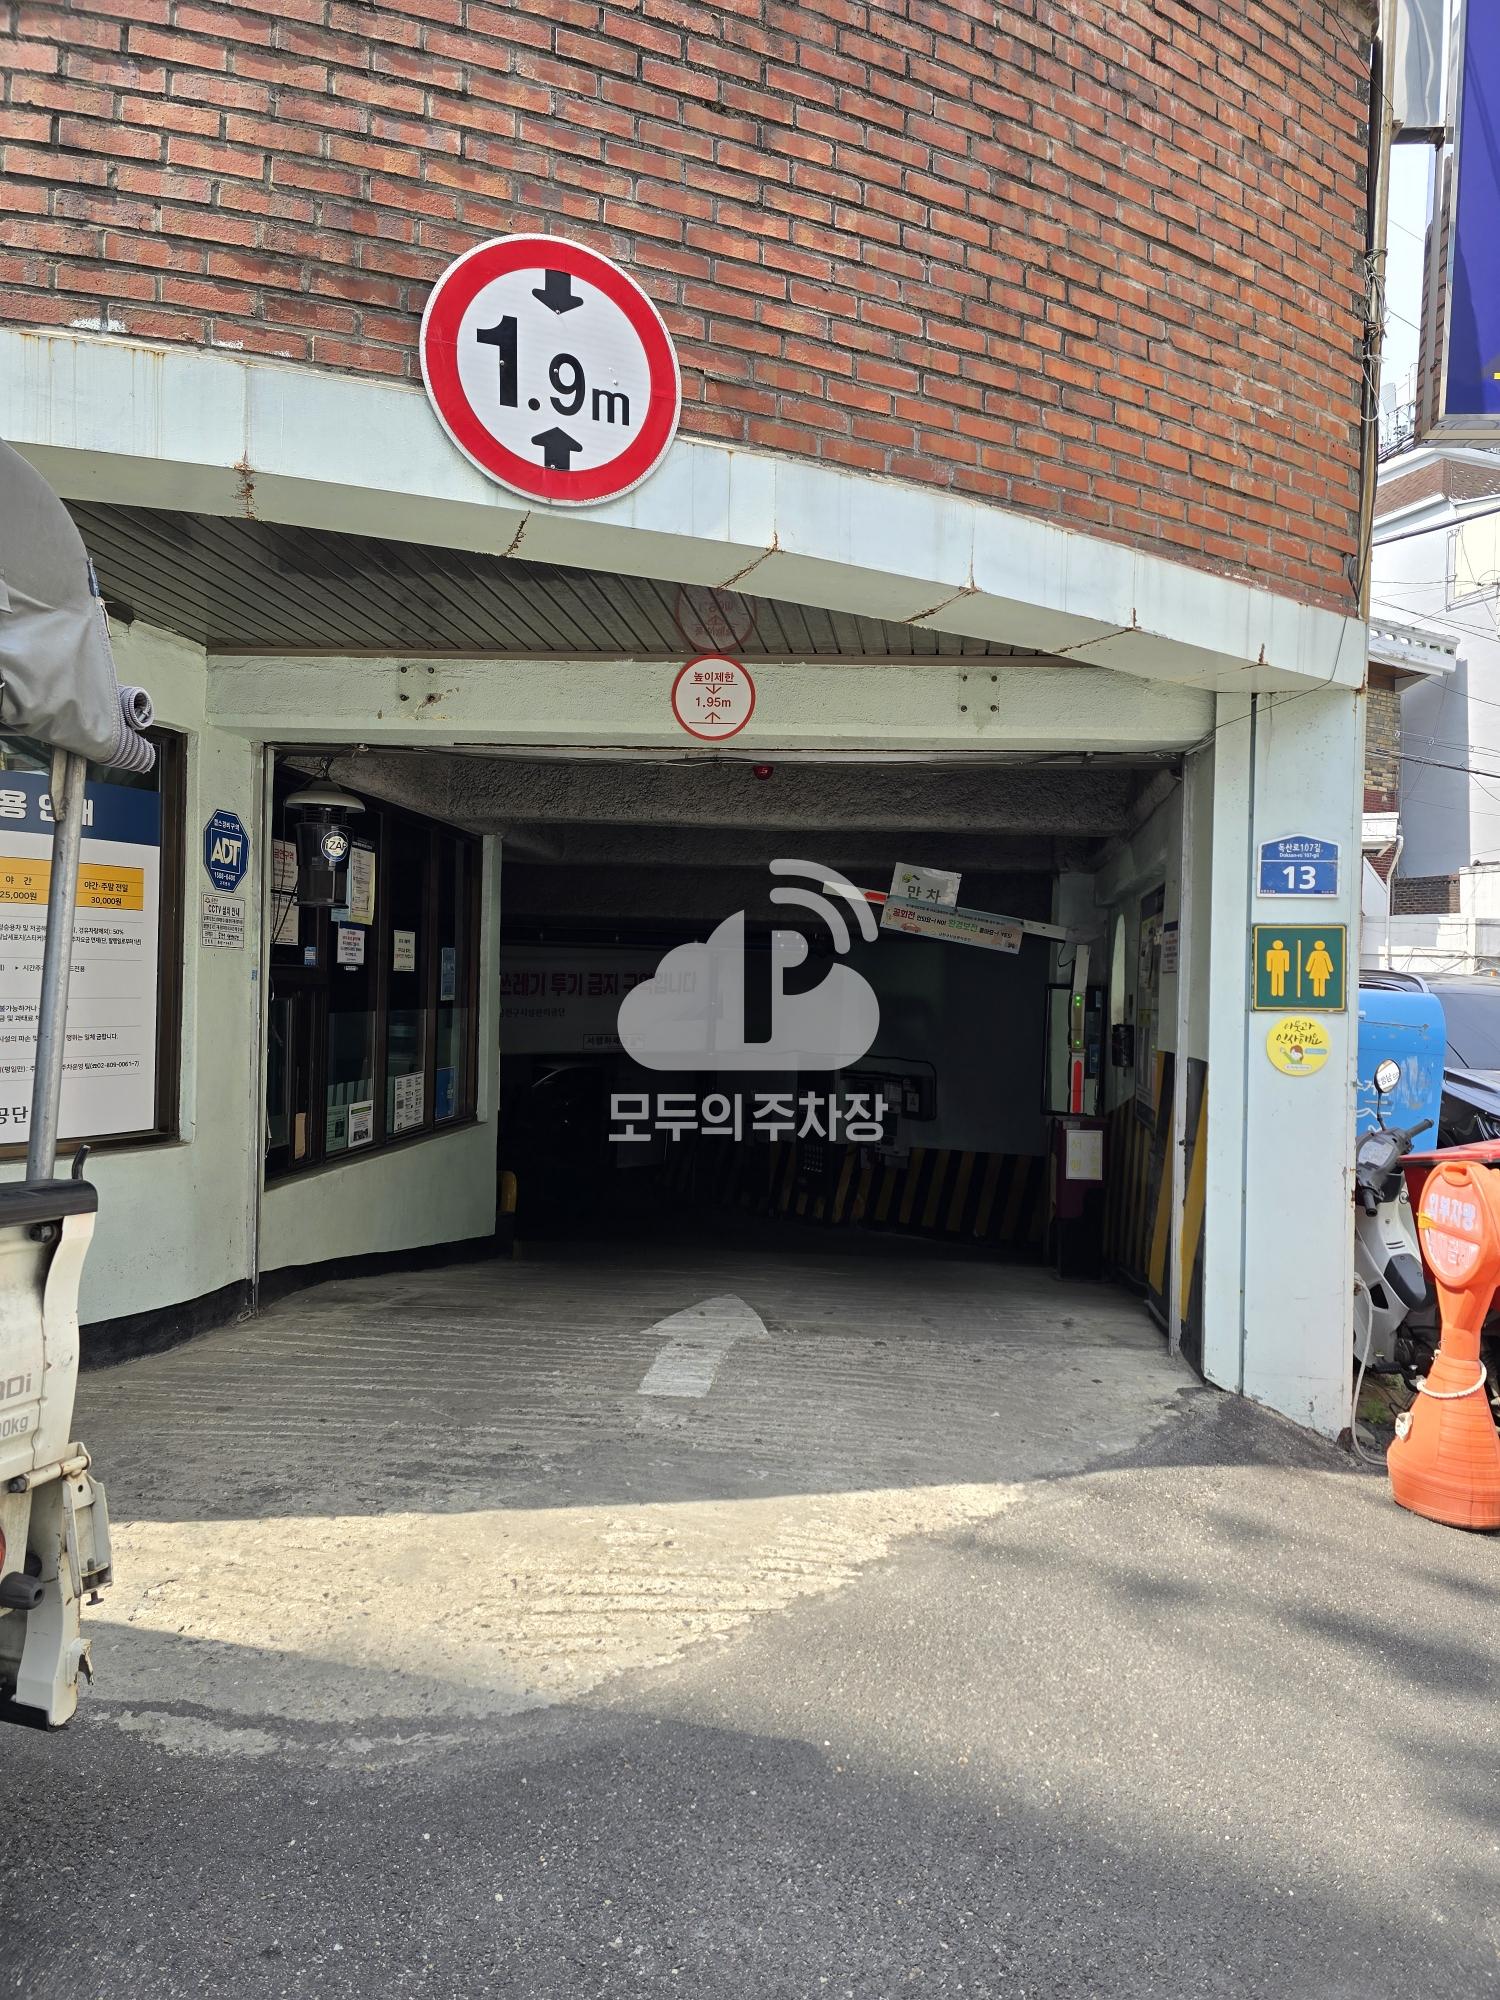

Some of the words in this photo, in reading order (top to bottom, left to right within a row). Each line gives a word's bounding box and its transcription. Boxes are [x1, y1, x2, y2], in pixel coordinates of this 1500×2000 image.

[476, 314, 630, 426] 1.9m
[693, 672, 735, 684] 높이제한
[694, 697, 732, 709] 1.95m
[211, 837, 241, 866] ADT
[1278, 843, 1321, 853] 독산로107길
[1282, 865, 1316, 890] 13
[91, 896, 122, 905] 30,000원
[892, 907, 916, 919] 공회전
[551, 971, 583, 996] 투기
[587, 971, 619, 996] 금지
[1275, 1033, 1323, 1045] 인사해요
[0, 1415, 29, 1438] 0kg
